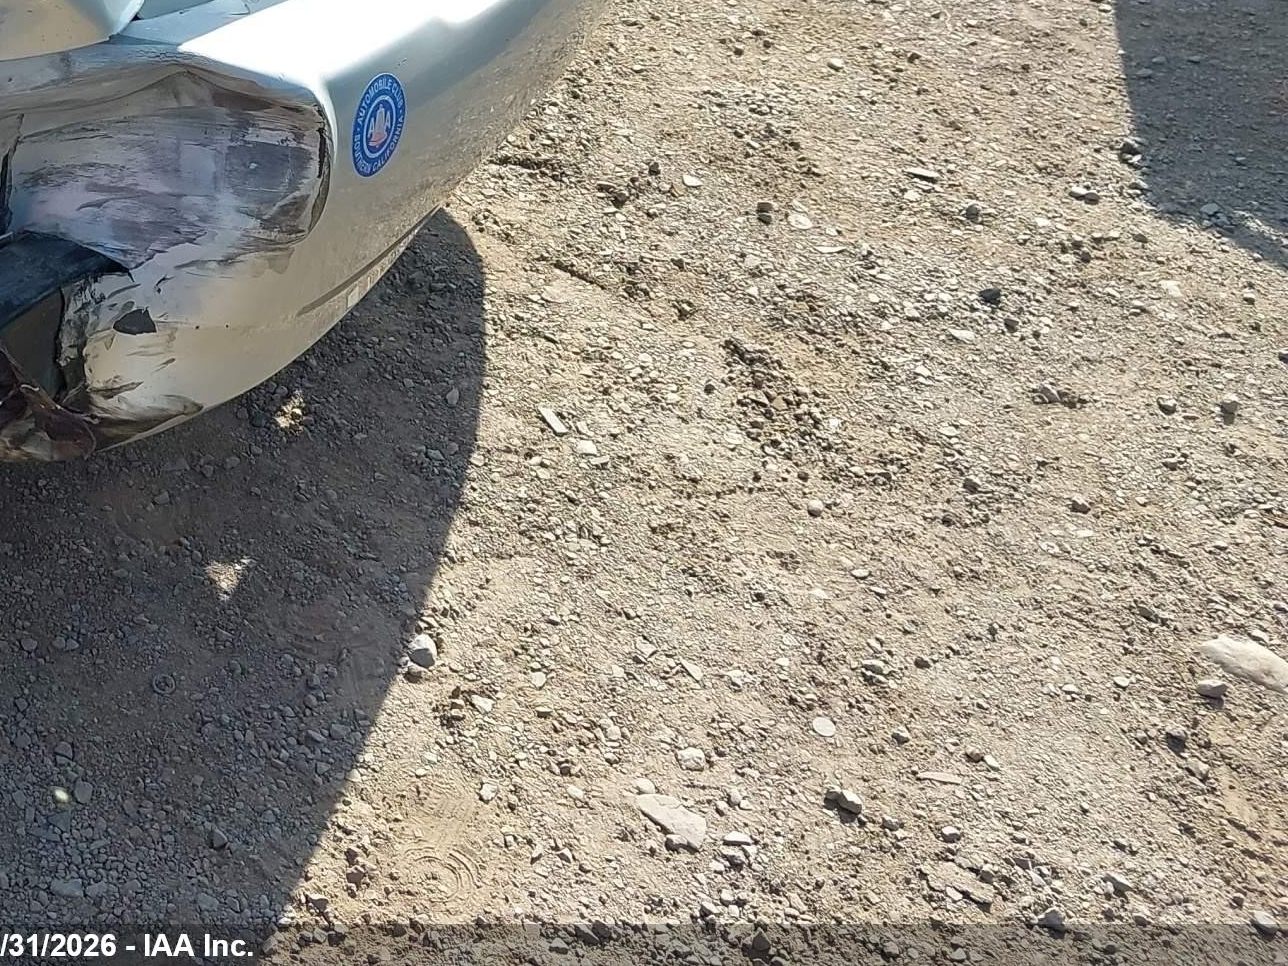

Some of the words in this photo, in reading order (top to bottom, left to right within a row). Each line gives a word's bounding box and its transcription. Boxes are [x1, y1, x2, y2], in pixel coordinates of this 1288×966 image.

[357, 78, 392, 125] AUTOMOBILE
[391, 83, 404, 108] CLUB
[354, 134, 371, 174] SOUTHERN
[372, 117, 404, 173] CALIFORNIA
